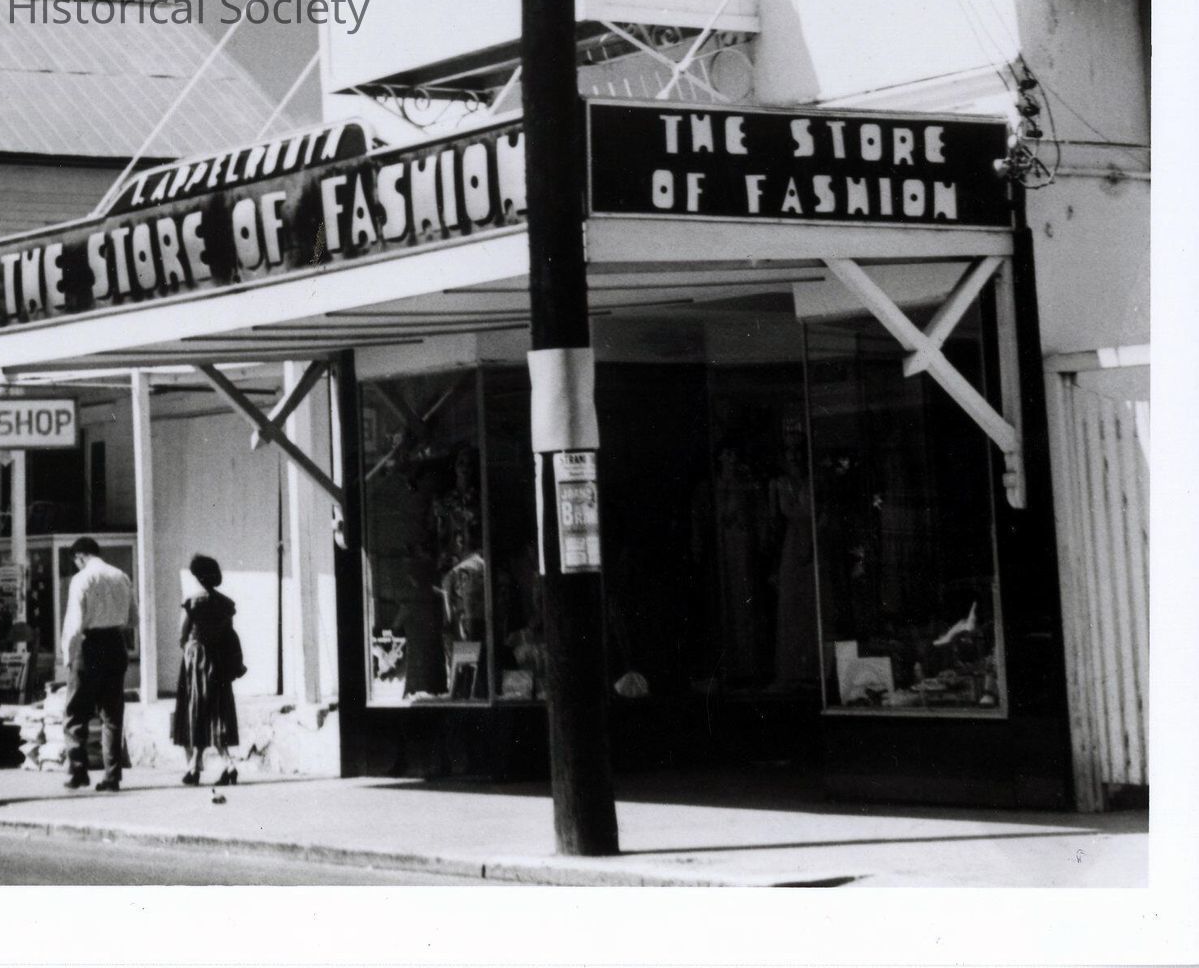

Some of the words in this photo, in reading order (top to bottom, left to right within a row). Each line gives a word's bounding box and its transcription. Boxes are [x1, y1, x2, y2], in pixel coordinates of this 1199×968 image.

[659, 114, 749, 156] THE
[791, 118, 947, 165] STORE
[651, 169, 704, 211] OF
[746, 175, 958, 220] FASHION
[1, 242, 66, 316] THE
[87, 210, 212, 301] STORE
[231, 190, 287, 270] OF
[320, 132, 527, 253] FASHION
